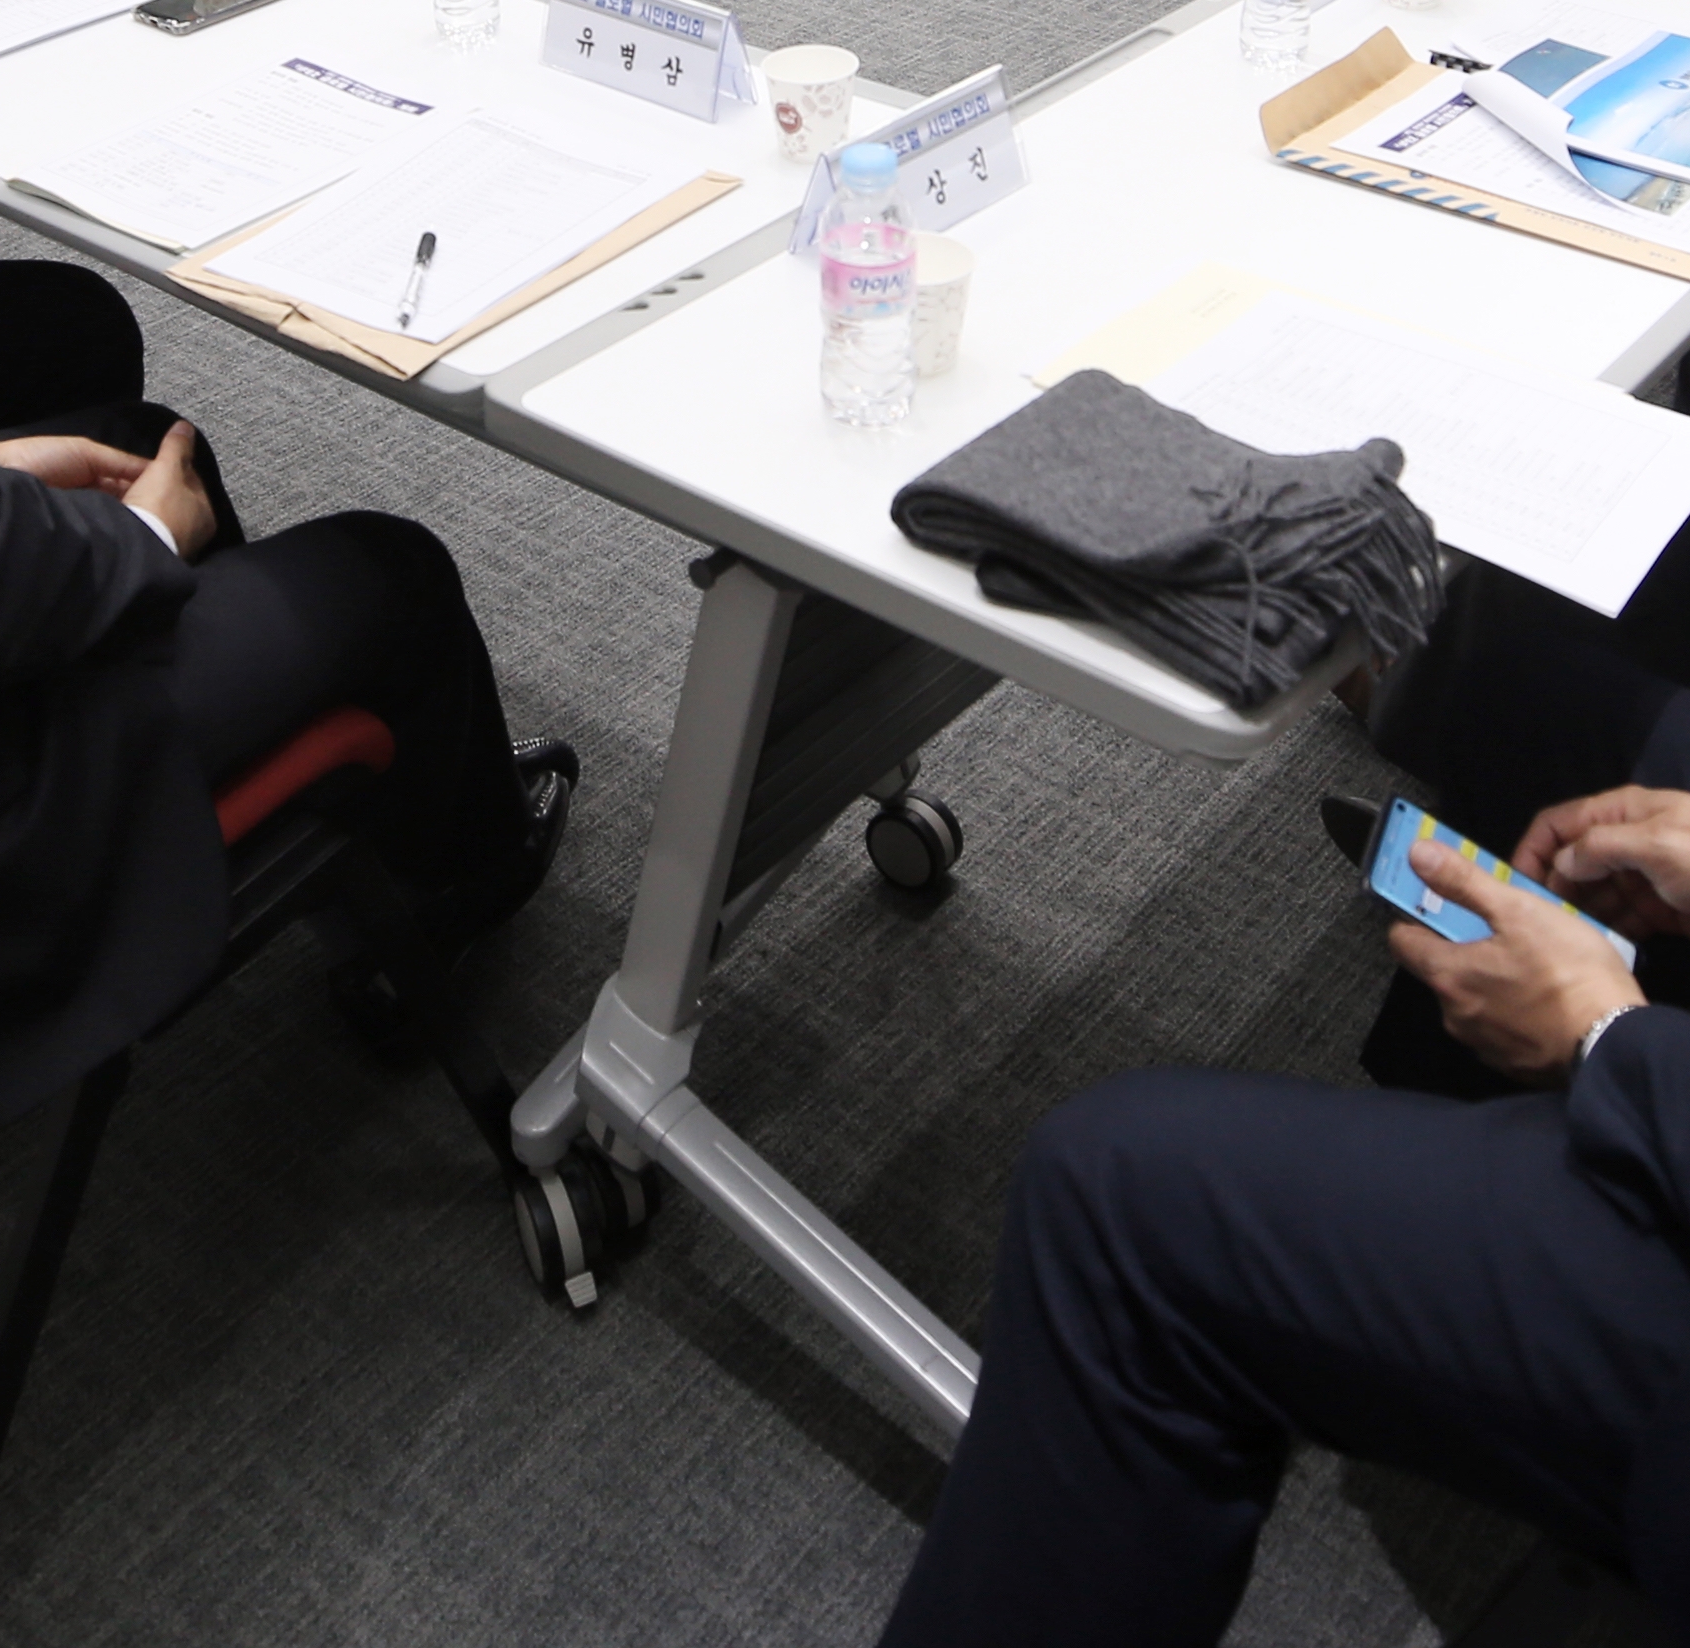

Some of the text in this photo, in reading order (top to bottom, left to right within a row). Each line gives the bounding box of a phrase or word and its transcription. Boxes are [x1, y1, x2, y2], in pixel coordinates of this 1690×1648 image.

[639, 2, 705, 39] 시민협의회
[885, 92, 991, 157] 로벌 시민협의회
